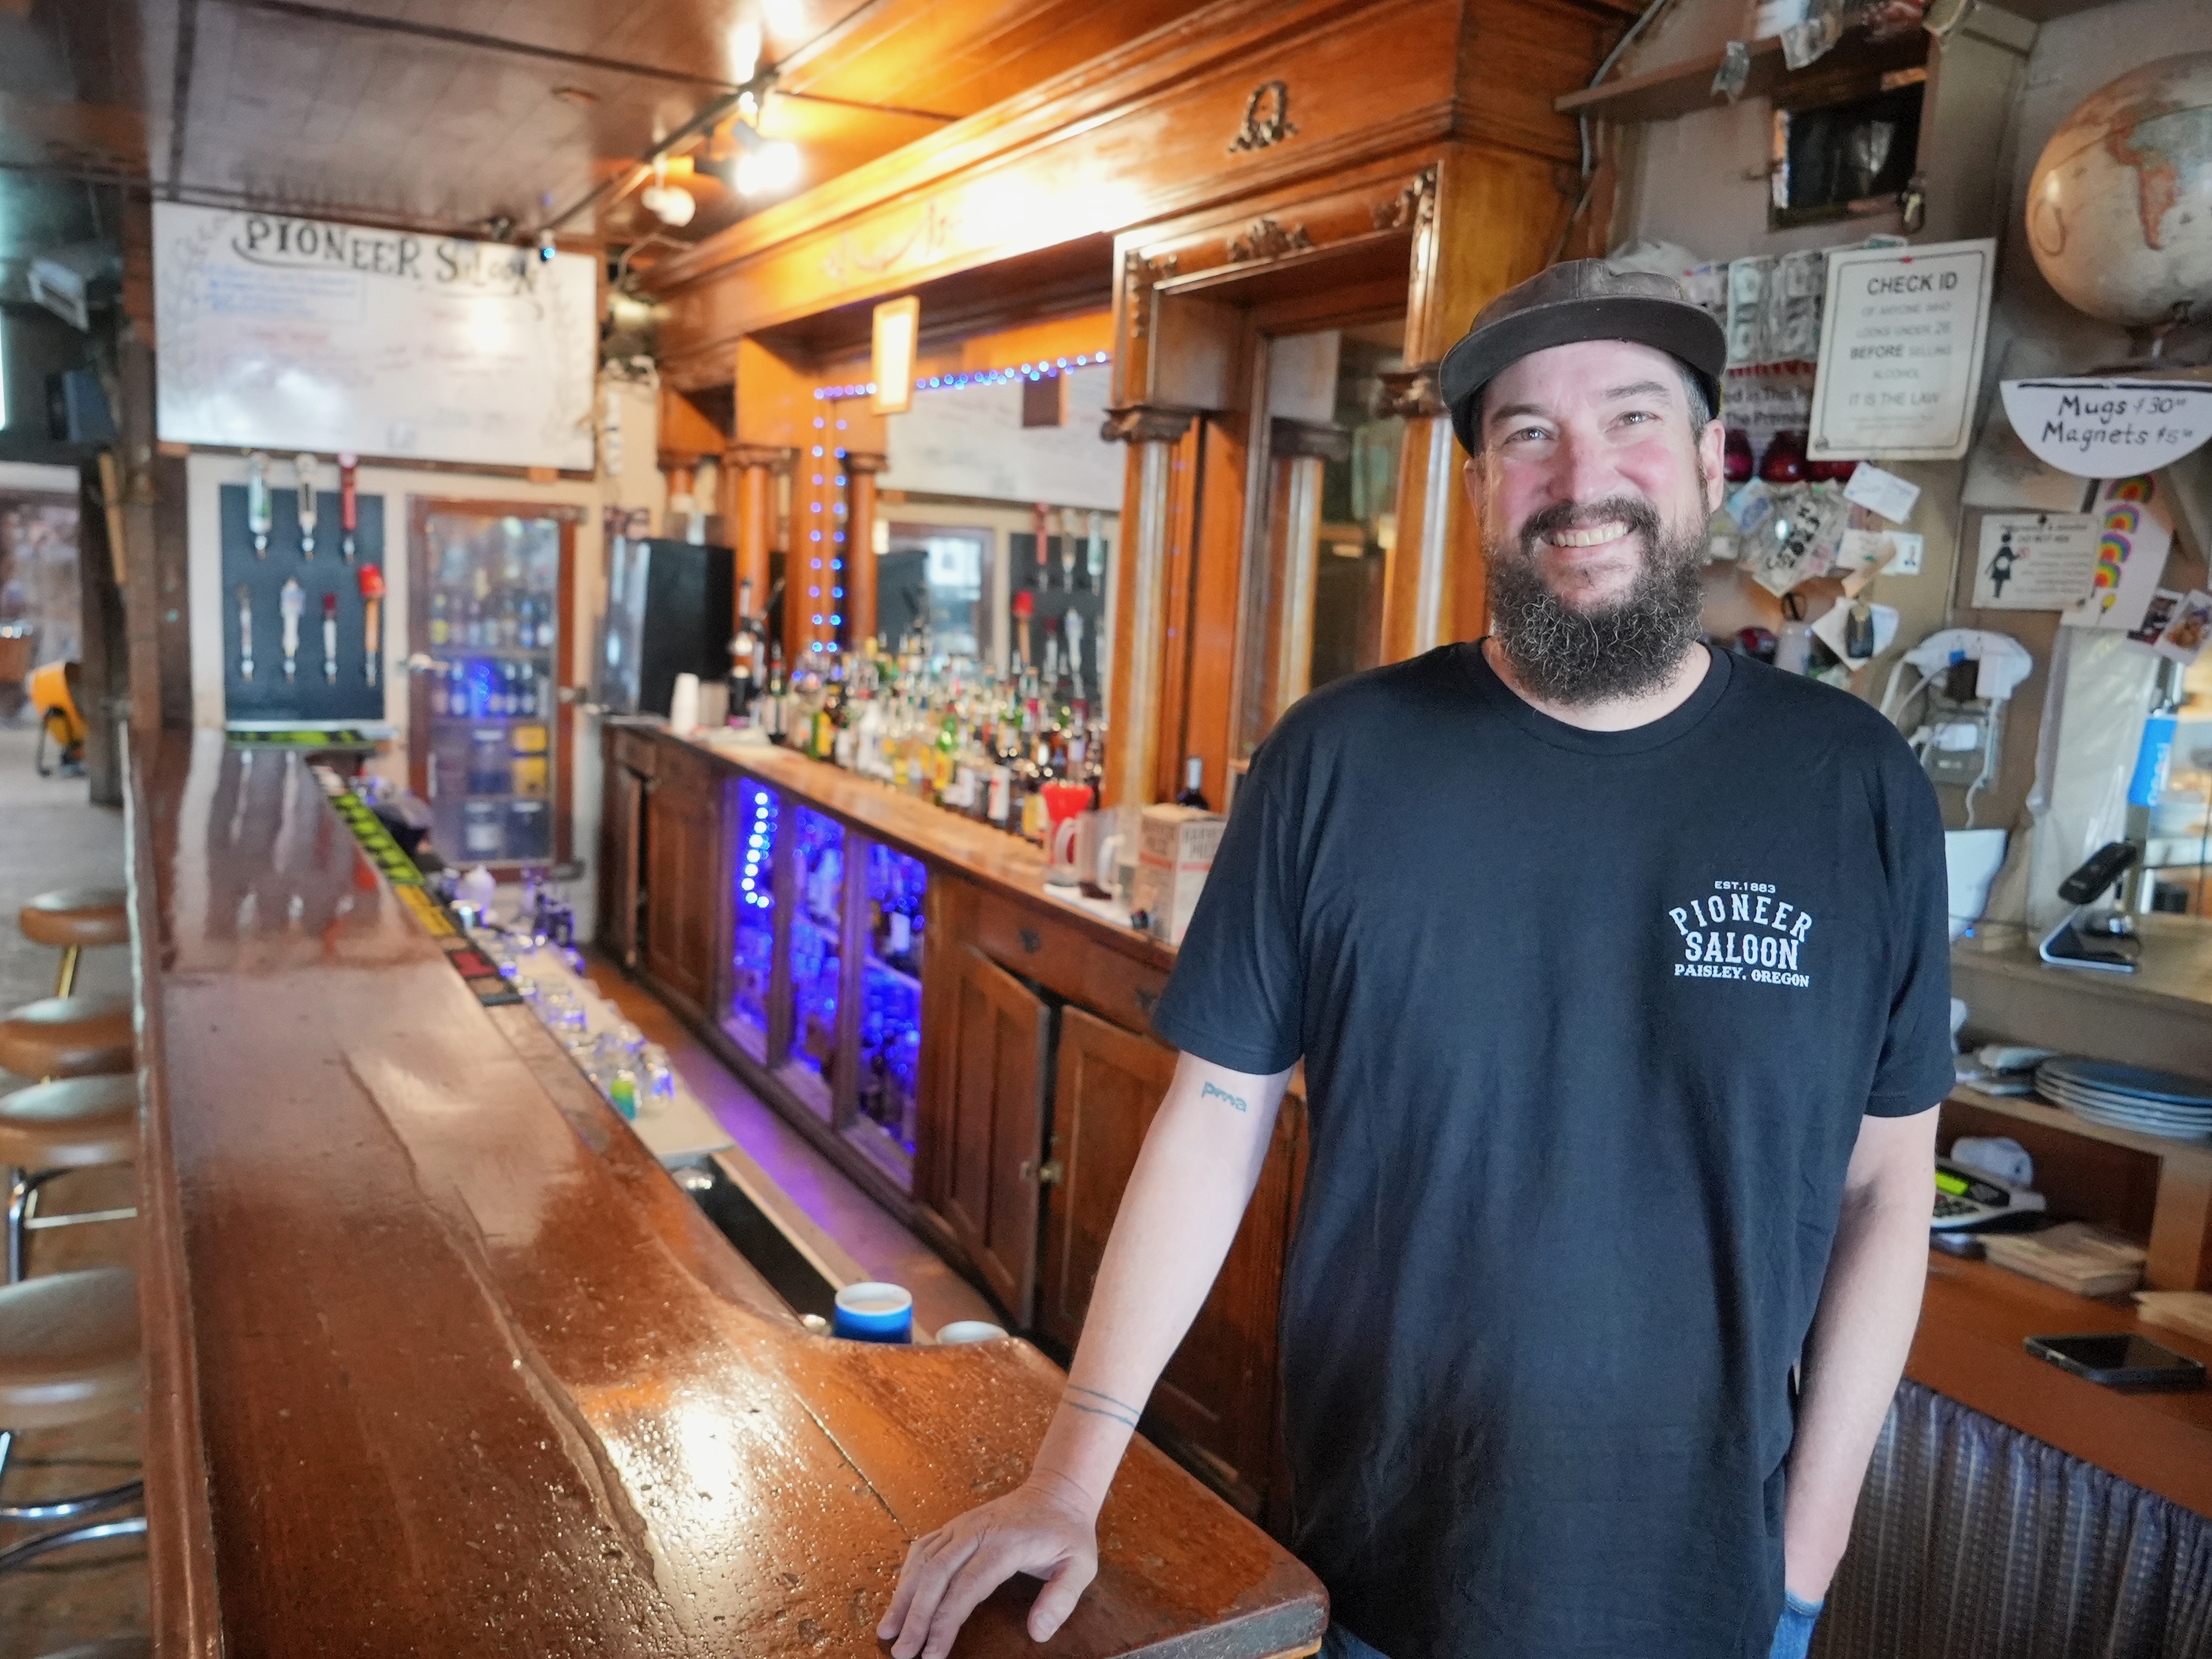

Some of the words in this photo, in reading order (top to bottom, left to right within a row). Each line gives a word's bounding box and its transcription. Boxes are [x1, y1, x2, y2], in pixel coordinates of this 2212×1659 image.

[246, 216, 422, 279] PIONEER
[1867, 275, 1933, 296] CHECK
[1939, 271, 1958, 291] ID
[1851, 344, 1903, 360] BEFORE
[1849, 392, 1860, 406] IT
[1863, 392, 1876, 406] IS
[1881, 391, 1906, 405] THE
[1910, 391, 1940, 405] LAW
[2058, 394, 2127, 424] Mugs
[2042, 421, 2148, 452] Magnets
[1668, 893, 1812, 942] PIONEER
[1685, 931, 1799, 971] SALOON
[1751, 969, 1810, 987] OREGON
